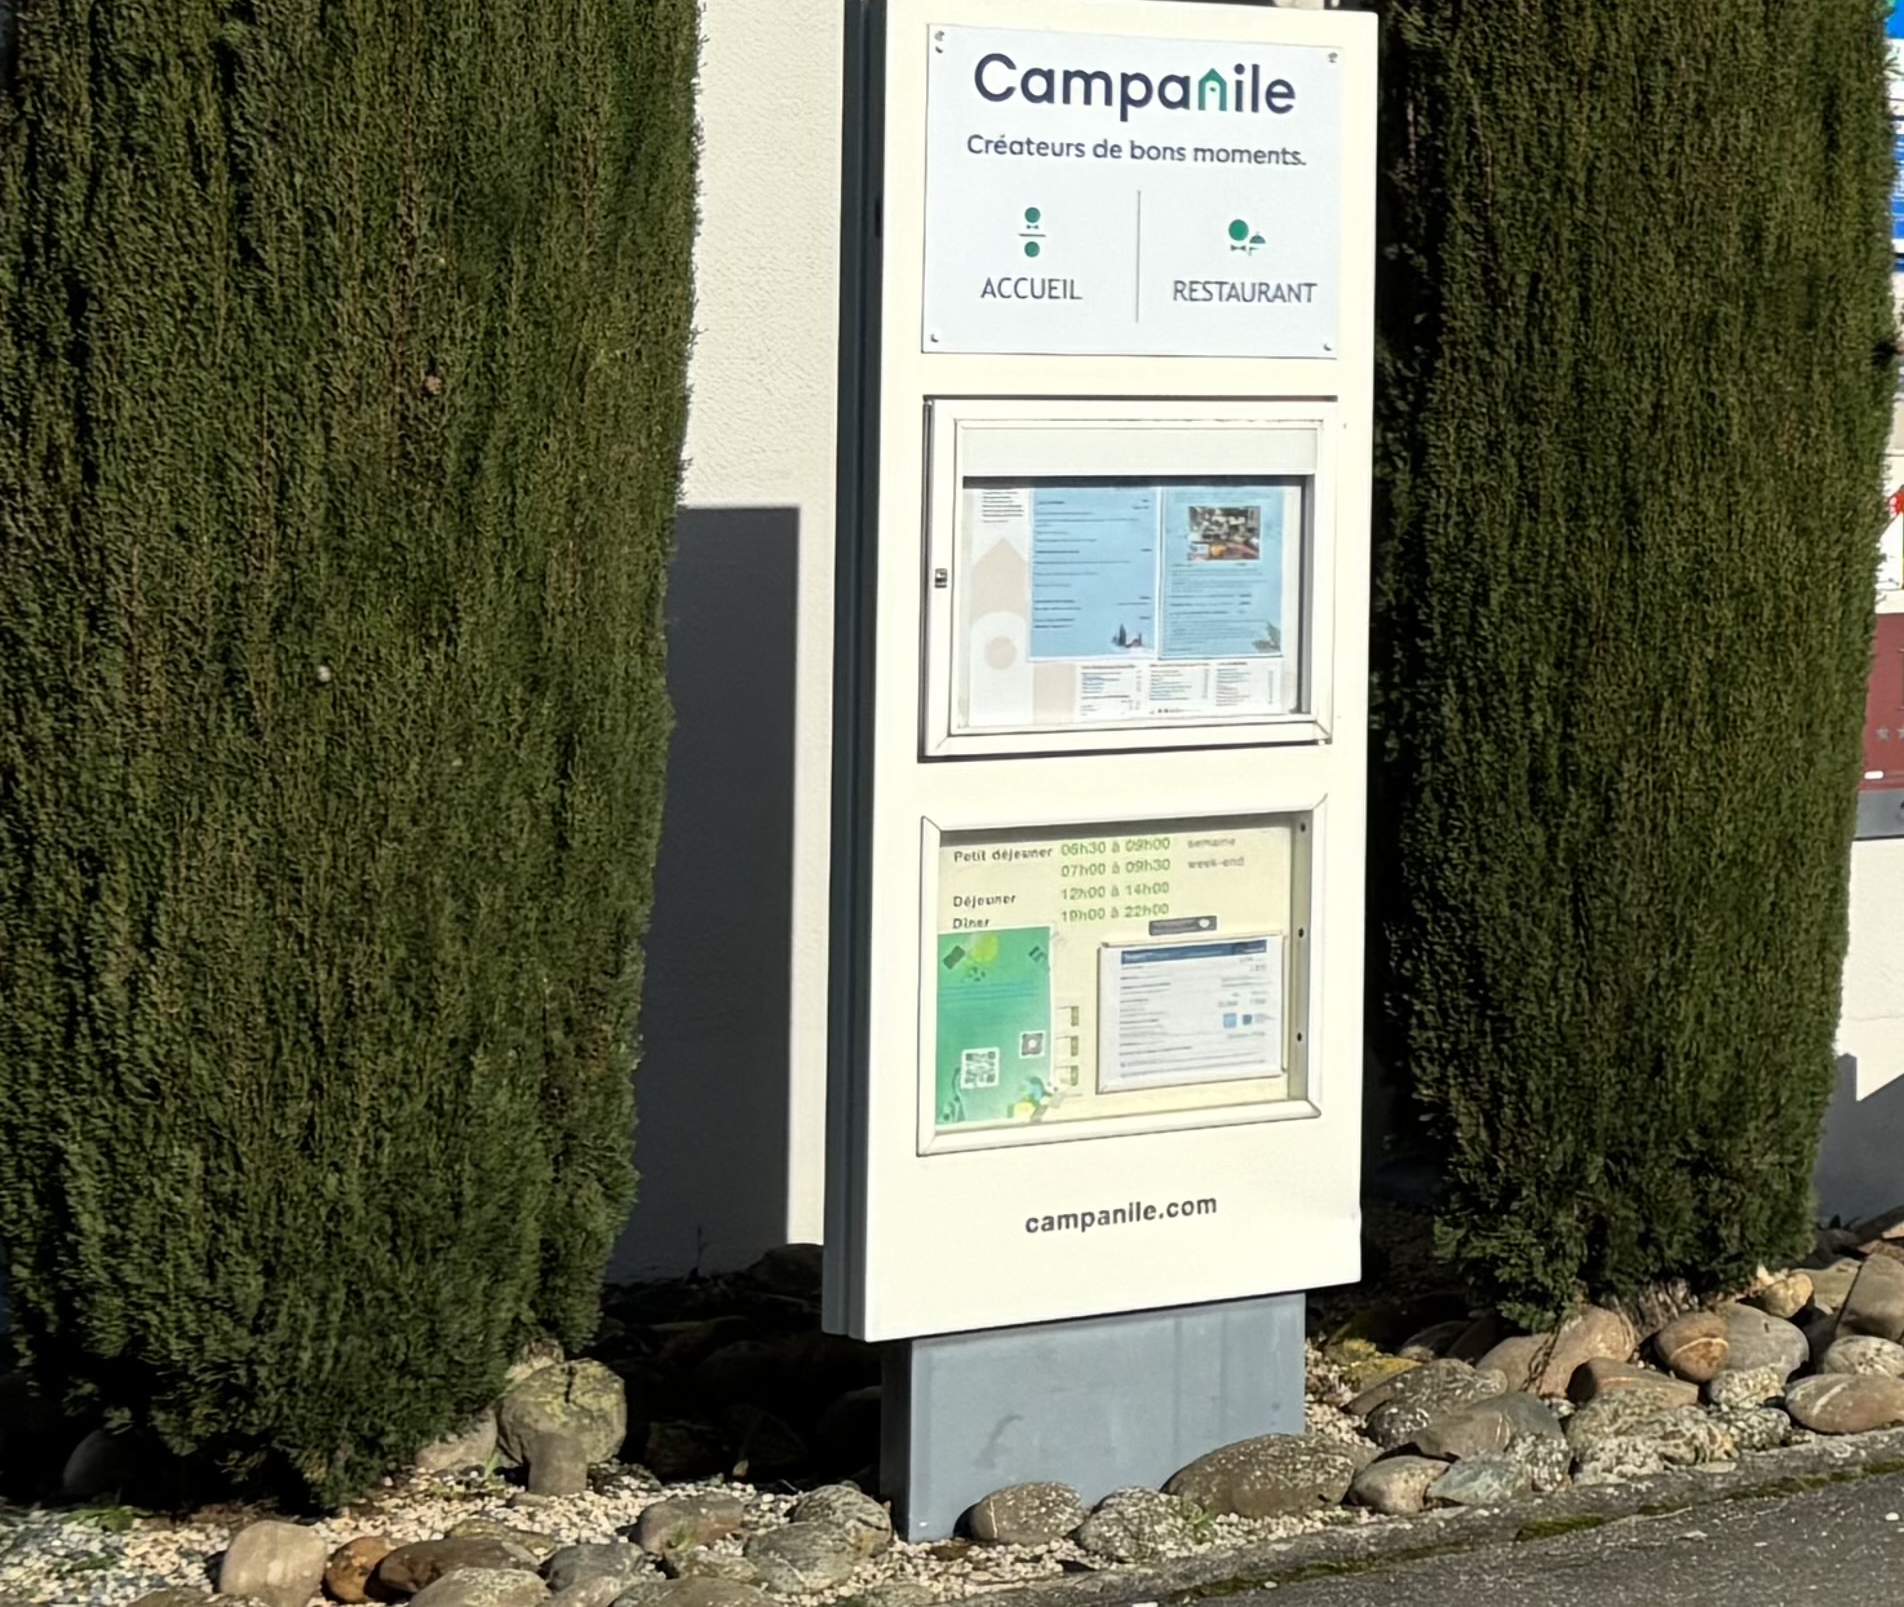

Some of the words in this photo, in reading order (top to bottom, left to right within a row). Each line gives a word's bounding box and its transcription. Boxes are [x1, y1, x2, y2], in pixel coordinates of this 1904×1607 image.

[974, 53, 1296, 122] Campanile
[966, 134, 1085, 158] Créateurs
[1092, 139, 1123, 159] de
[1129, 140, 1186, 162] bons
[1193, 146, 1306, 166] moments.
[980, 277, 1082, 301] ACCUEIL
[1173, 280, 1318, 304] RESTAURANT
[953, 850, 986, 863] Petit
[1061, 863, 1106, 878] 07h00
[1125, 859, 1171, 874] 09h30
[1061, 885, 1105, 900] 12h00
[1126, 881, 1170, 896] 14h00
[1124, 903, 1170, 918] 22h00
[1025, 1197, 1217, 1234] campanile.com
